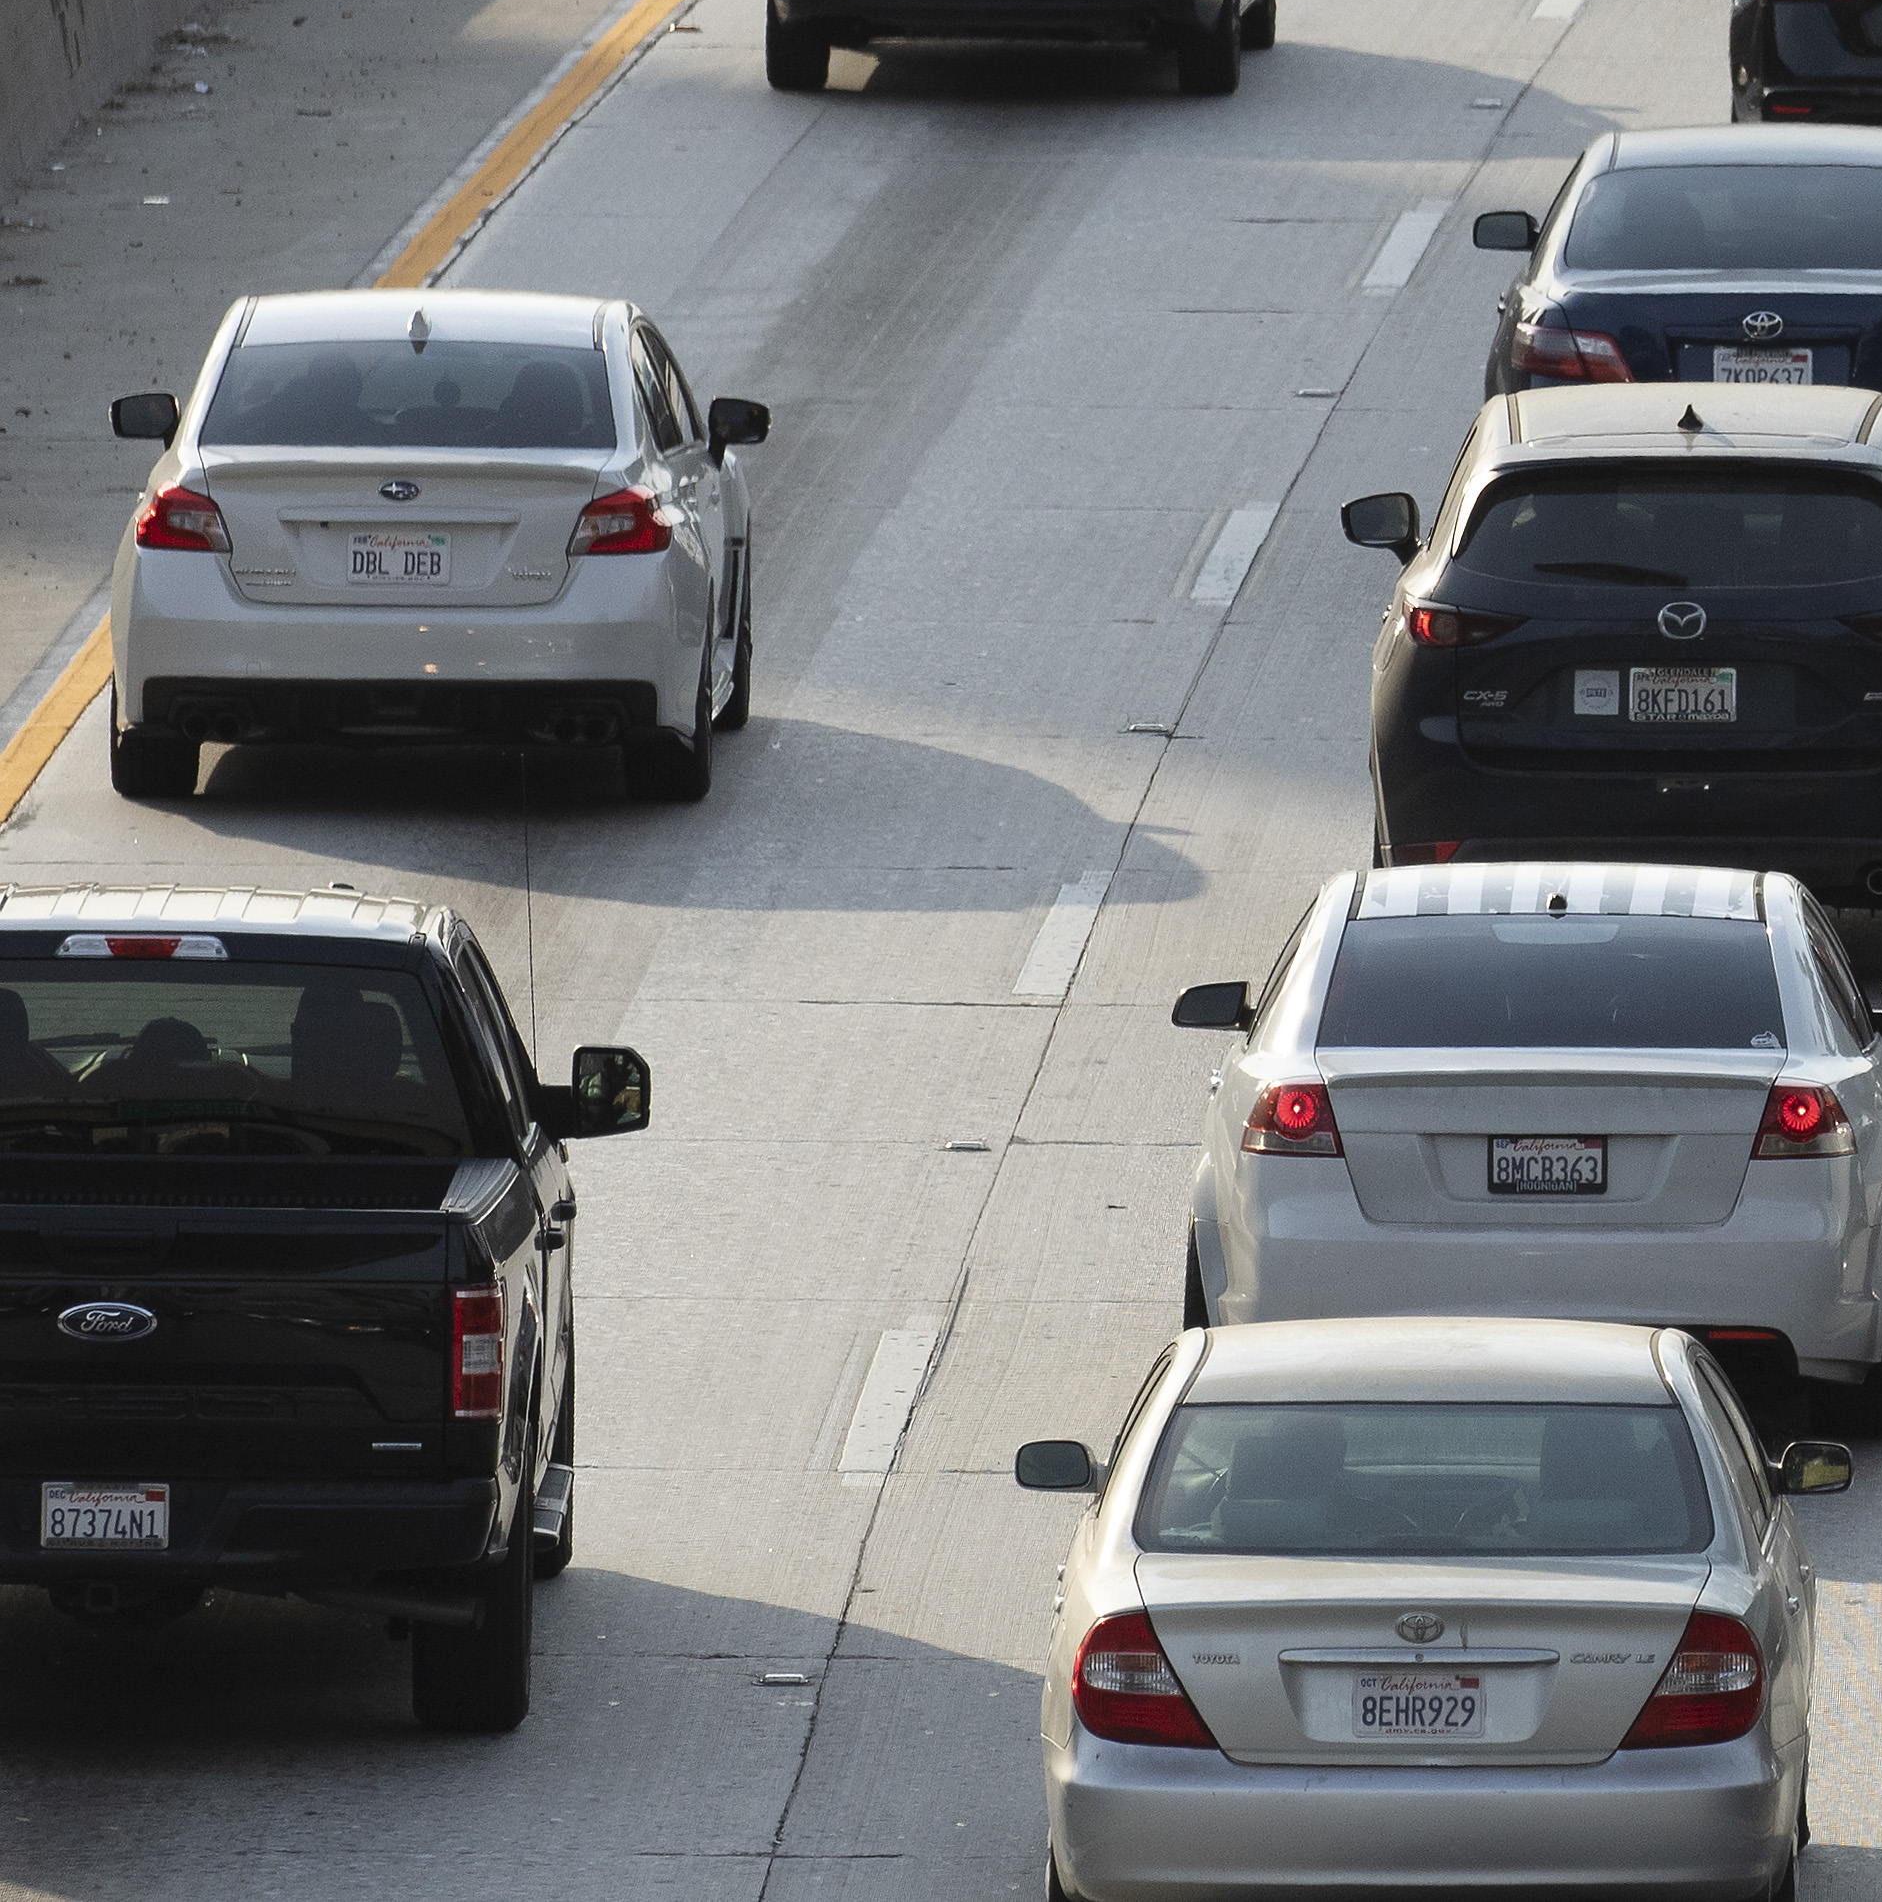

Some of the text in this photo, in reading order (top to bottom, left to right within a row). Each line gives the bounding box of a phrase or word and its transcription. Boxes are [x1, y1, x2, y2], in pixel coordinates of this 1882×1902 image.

[371, 534, 428, 550] California
[352, 551, 442, 576] DBL DEB
[1657, 668, 1710, 677] GLENDALE
[1461, 689, 1507, 702] CX-5
[1637, 689, 1729, 713] 8KFD161
[1635, 712, 1677, 721] STAR
[1512, 1137, 1584, 1155] California
[1497, 1156, 1599, 1184] 8MCB363
[80, 1309, 134, 1333] Ford
[49, 1489, 146, 1507] DEC California
[50, 1507, 159, 1539] 87374N1
[1193, 1654, 1240, 1665] TOYOTA
[1568, 1652, 1656, 1664] CAMRY LE
[1360, 1676, 1454, 1696] OCT California
[1361, 1695, 1477, 1728] 8EHR929
